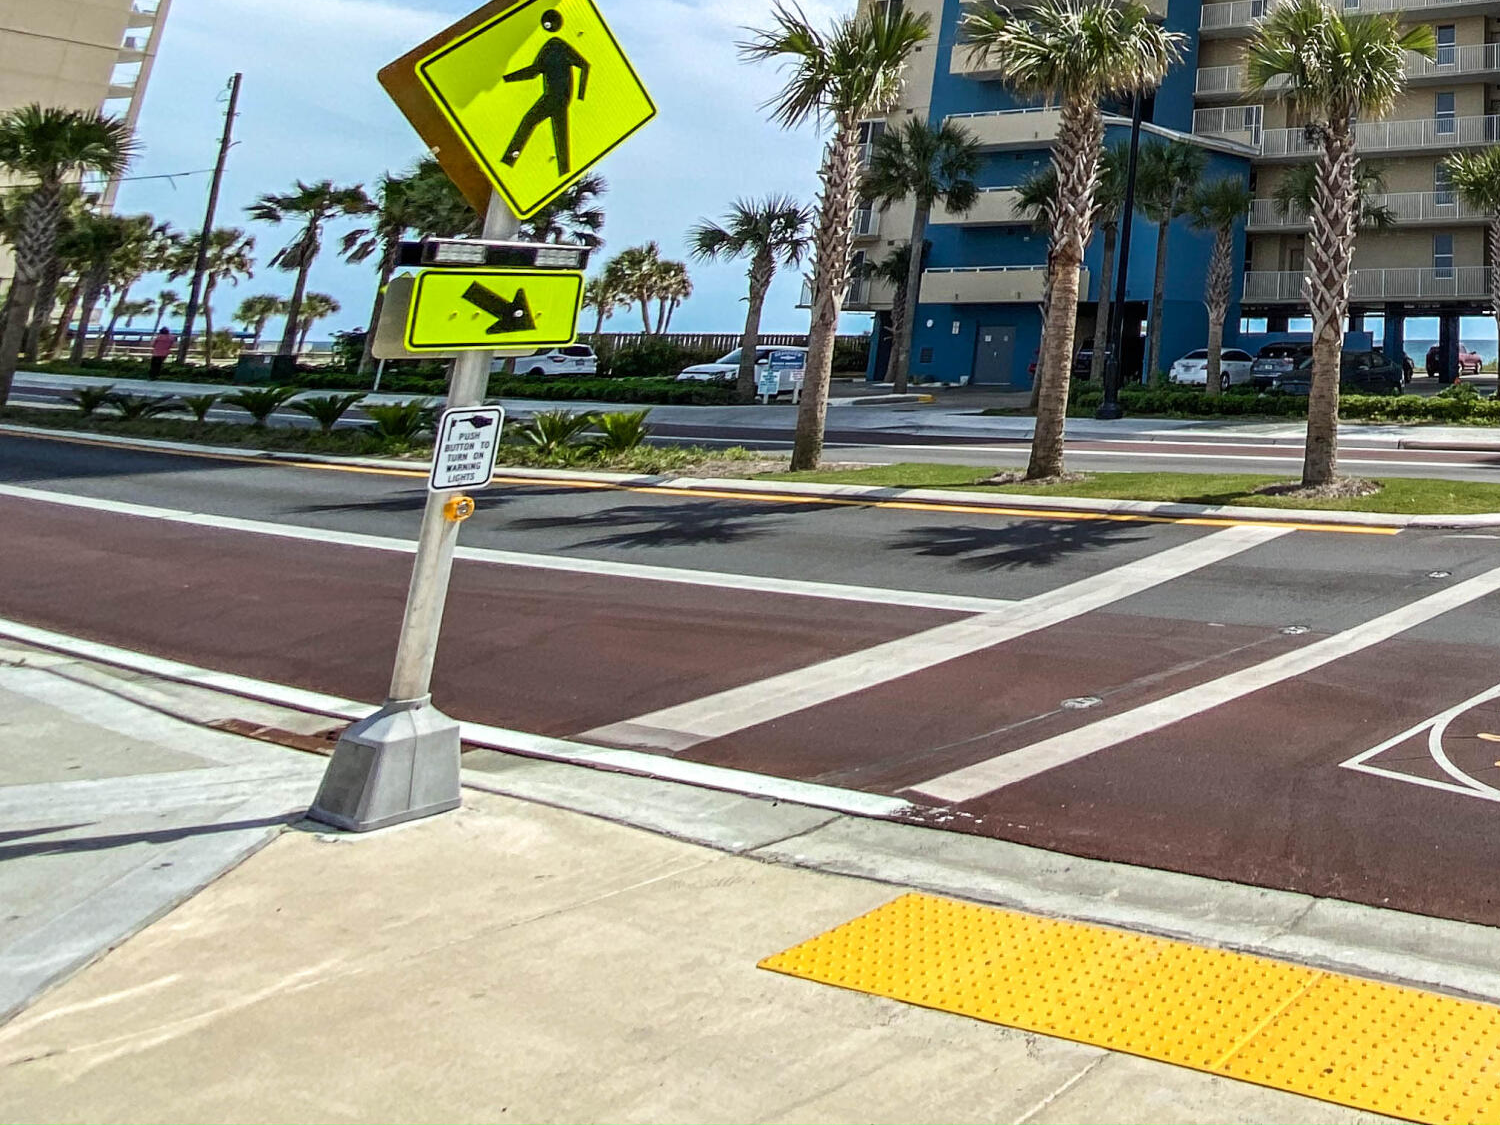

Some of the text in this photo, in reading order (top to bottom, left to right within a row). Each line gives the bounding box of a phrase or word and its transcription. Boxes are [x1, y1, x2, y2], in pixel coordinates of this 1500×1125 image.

[459, 432, 480, 440] PUSH
[445, 443, 474, 452] BUTTON
[448, 453, 468, 462] TURN
[447, 462, 481, 472] WARNING
[448, 473, 474, 482] LIGHTS
